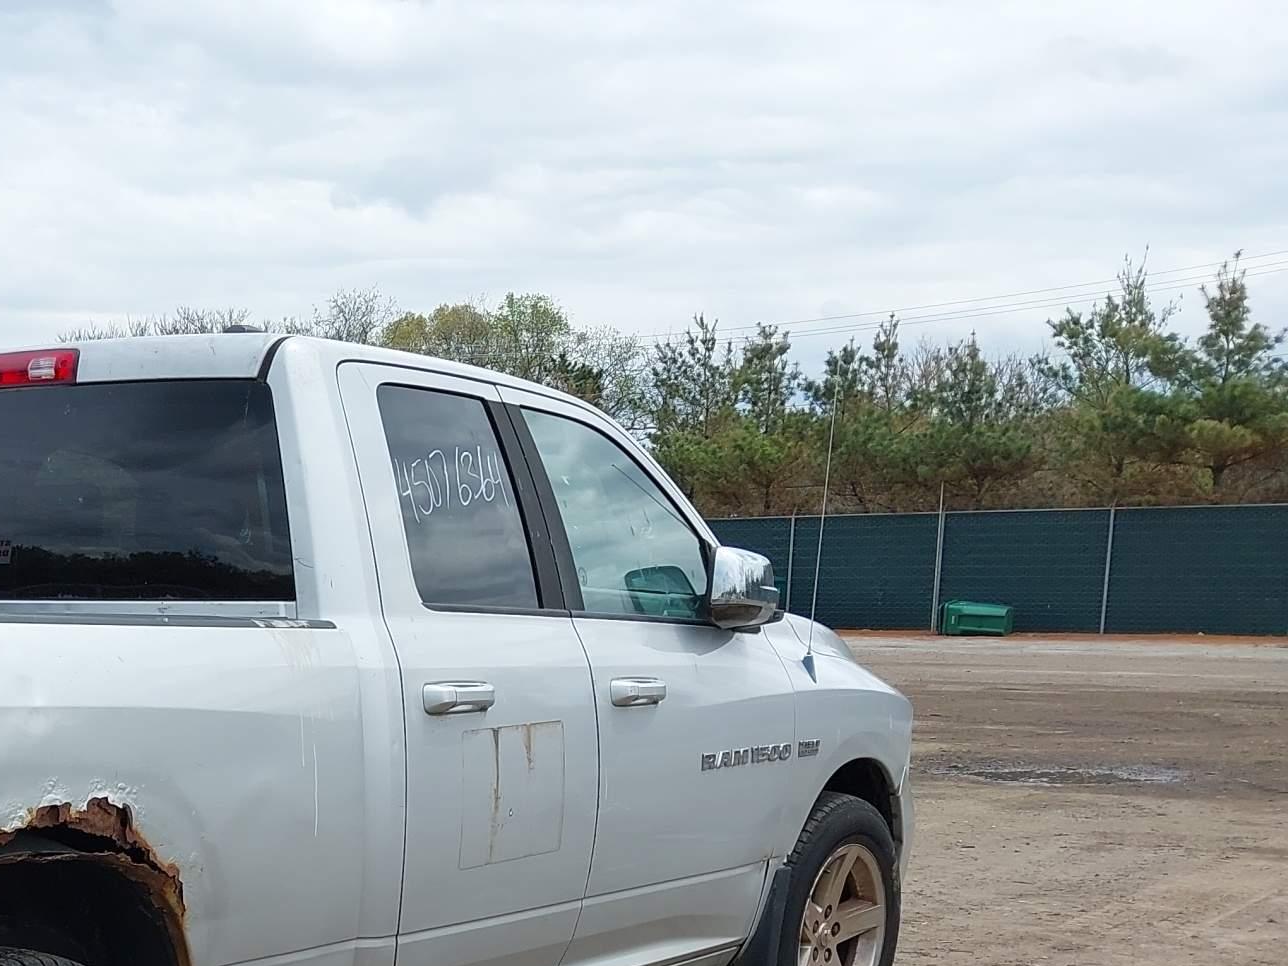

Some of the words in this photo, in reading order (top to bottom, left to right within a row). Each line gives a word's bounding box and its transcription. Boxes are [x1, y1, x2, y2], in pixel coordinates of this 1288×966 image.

[394, 445, 510, 523] 45076364
[701, 748, 750, 771] RAM
[750, 743, 792, 764] 1500
